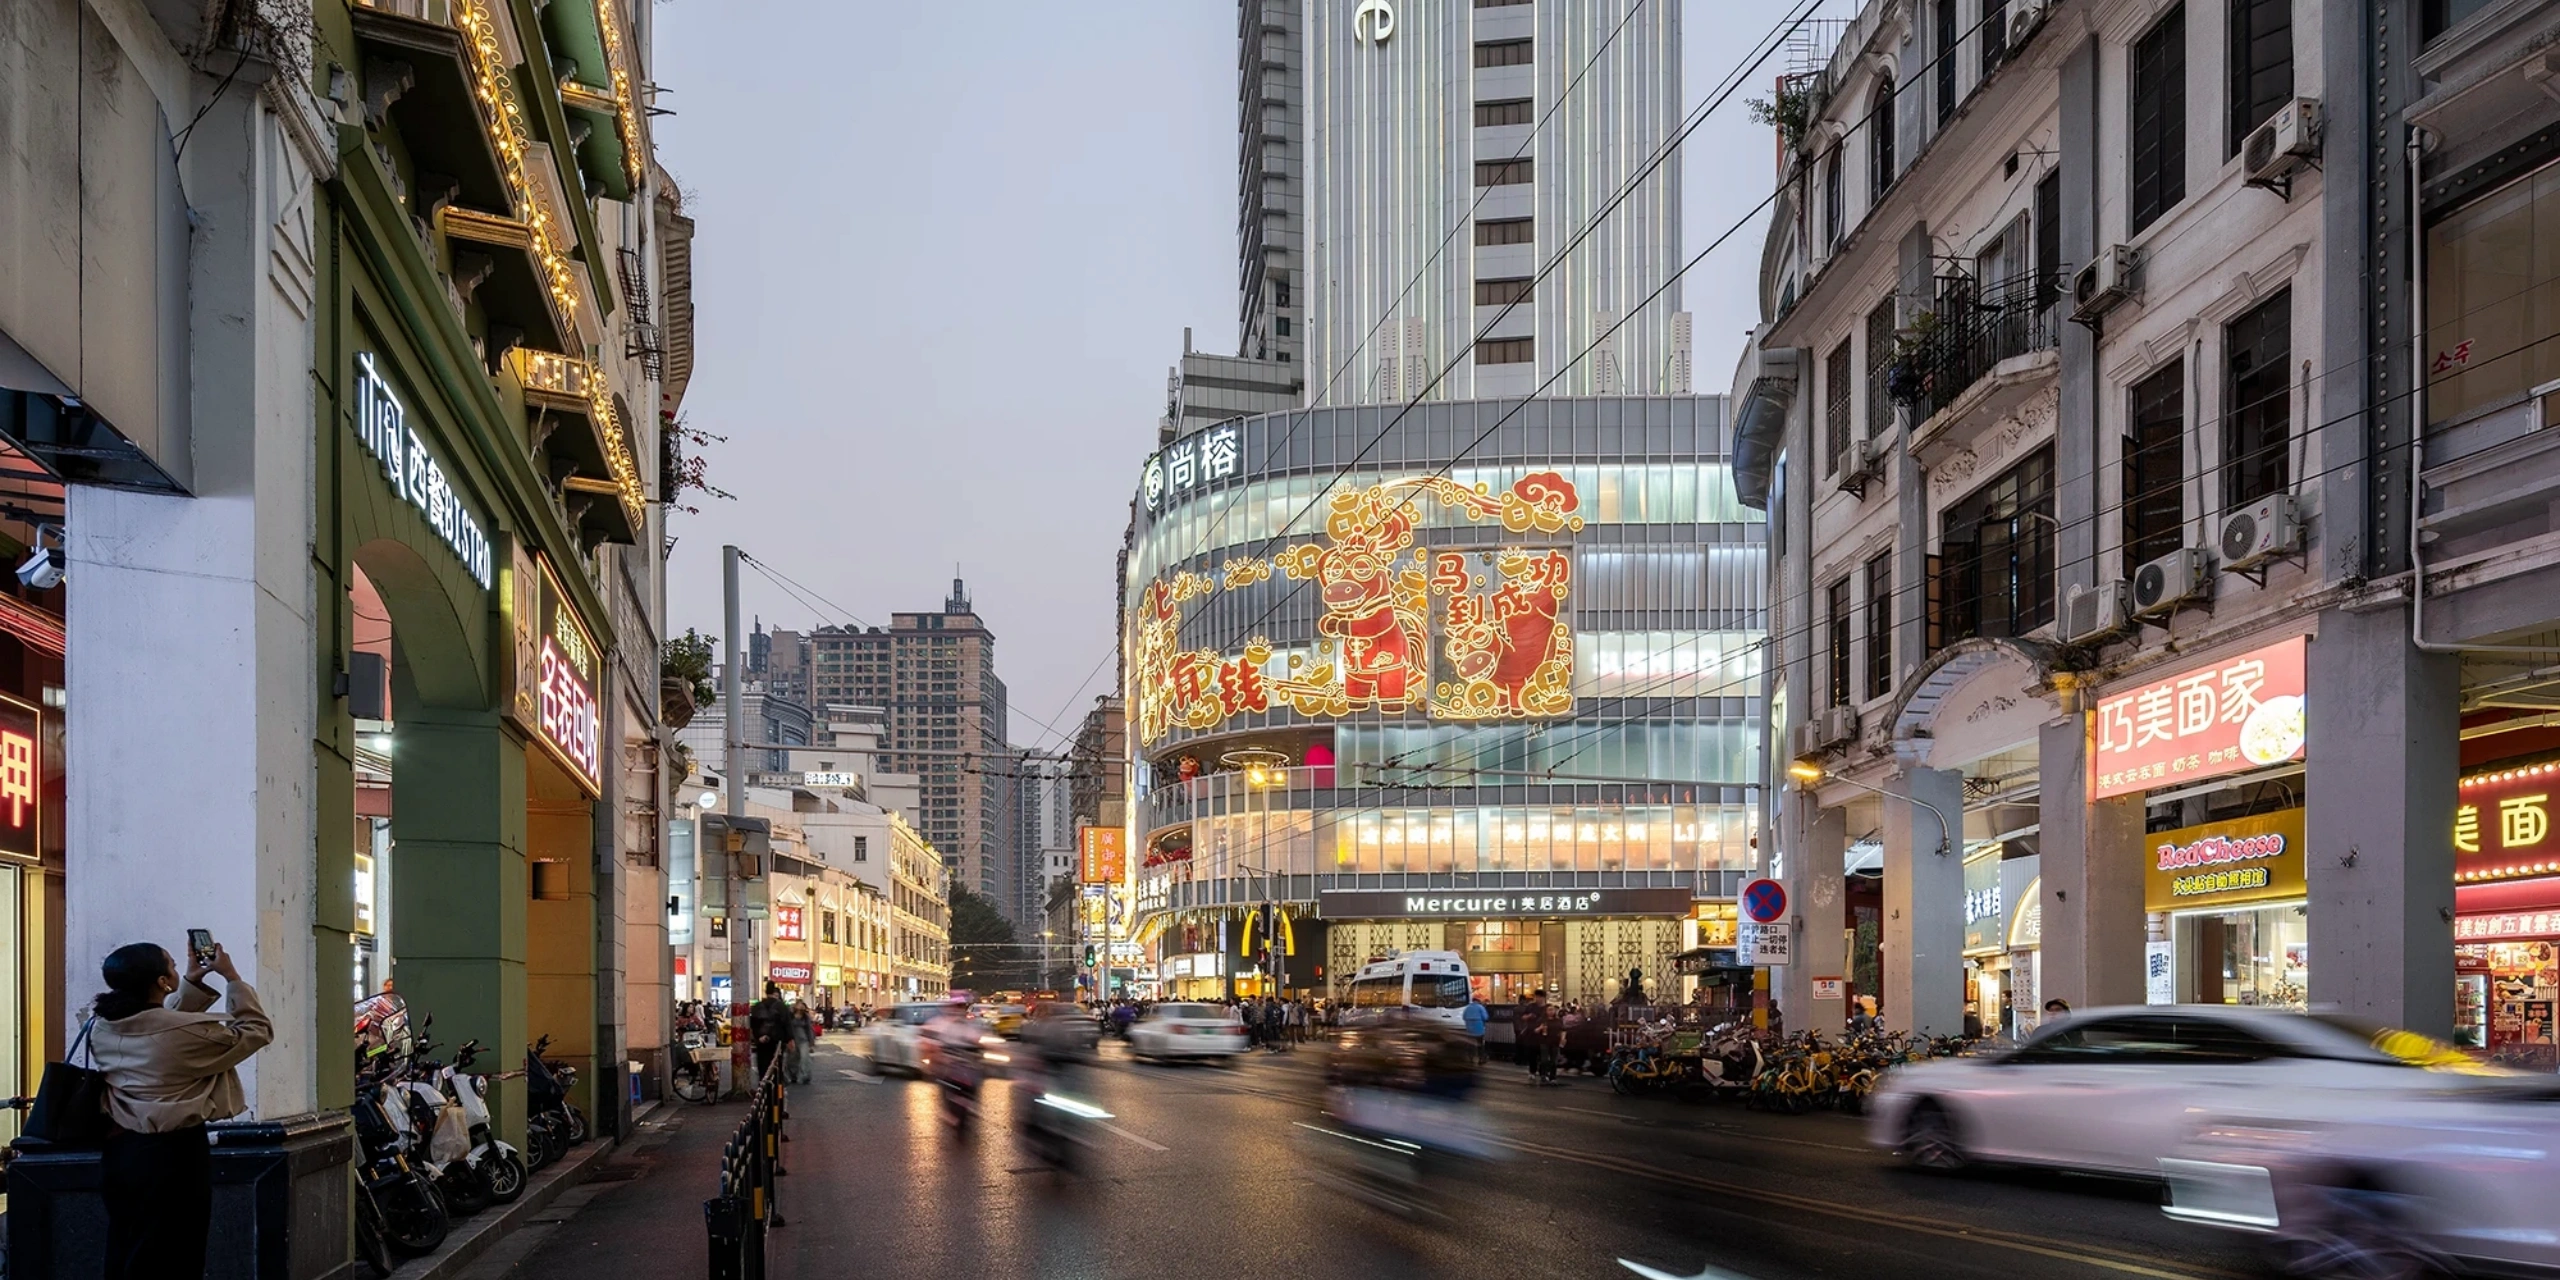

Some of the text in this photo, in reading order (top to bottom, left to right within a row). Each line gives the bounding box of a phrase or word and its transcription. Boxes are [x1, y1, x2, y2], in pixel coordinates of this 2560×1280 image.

[2431, 339, 2475, 376] 소주
[1169, 427, 1238, 496] 尚榕
[540, 634, 600, 783] 名表回收
[2099, 659, 2265, 753] 巧美面家
[2098, 745, 2240, 789] 港式云吞面 奶茶 咖啡
[2157, 833, 2285, 870] RedCheese
[1406, 896, 1590, 912] Mercure 美居酒店
